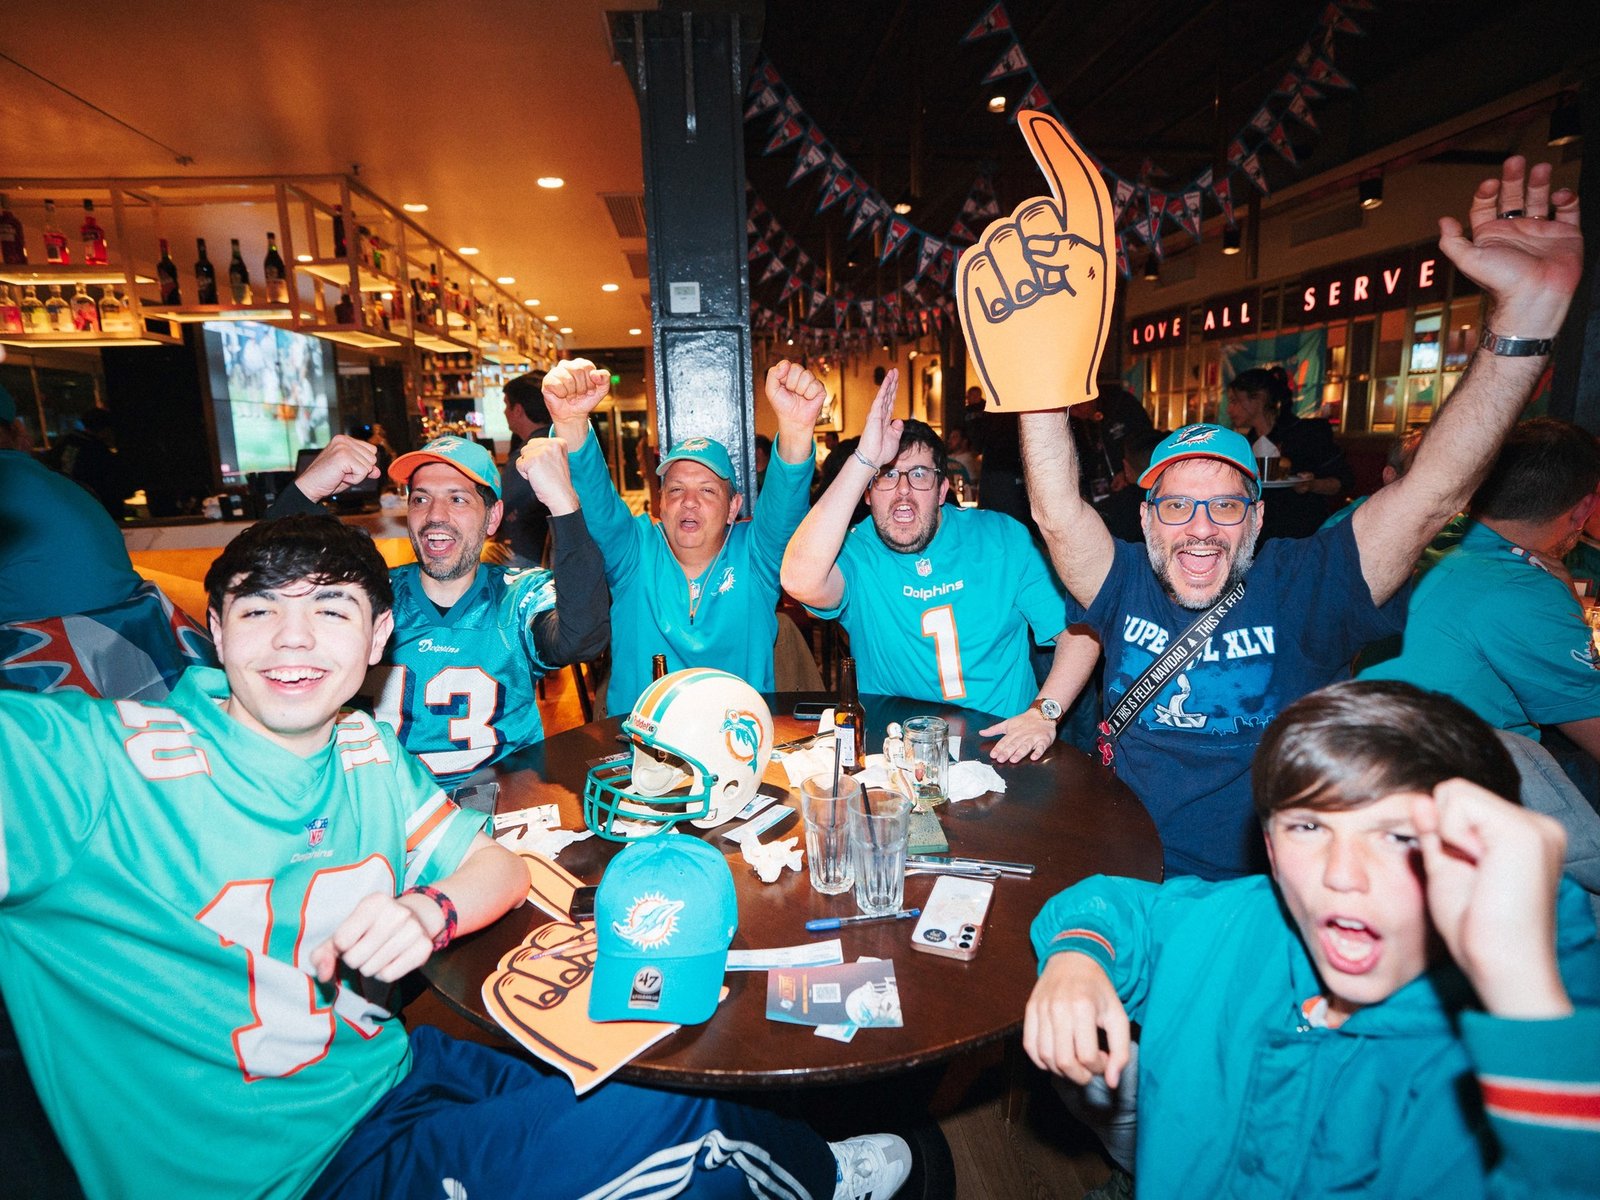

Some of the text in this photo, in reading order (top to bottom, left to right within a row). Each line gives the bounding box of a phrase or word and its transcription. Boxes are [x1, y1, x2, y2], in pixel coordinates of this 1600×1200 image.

[1132, 259, 1436, 345] LOVE ALL SERVE
[903, 579, 964, 601] Dolphins
[1123, 614, 1169, 655] UPE
[1222, 626, 1276, 659] XLV
[1194, 615, 1220, 638] THIS
[921, 603, 966, 700] 1
[1150, 645, 1189, 684] NAVIDAD
[1132, 680, 1156, 703] FELIZ
[1117, 705, 1132, 722] THIS
[1128, 697, 1138, 710] IS
